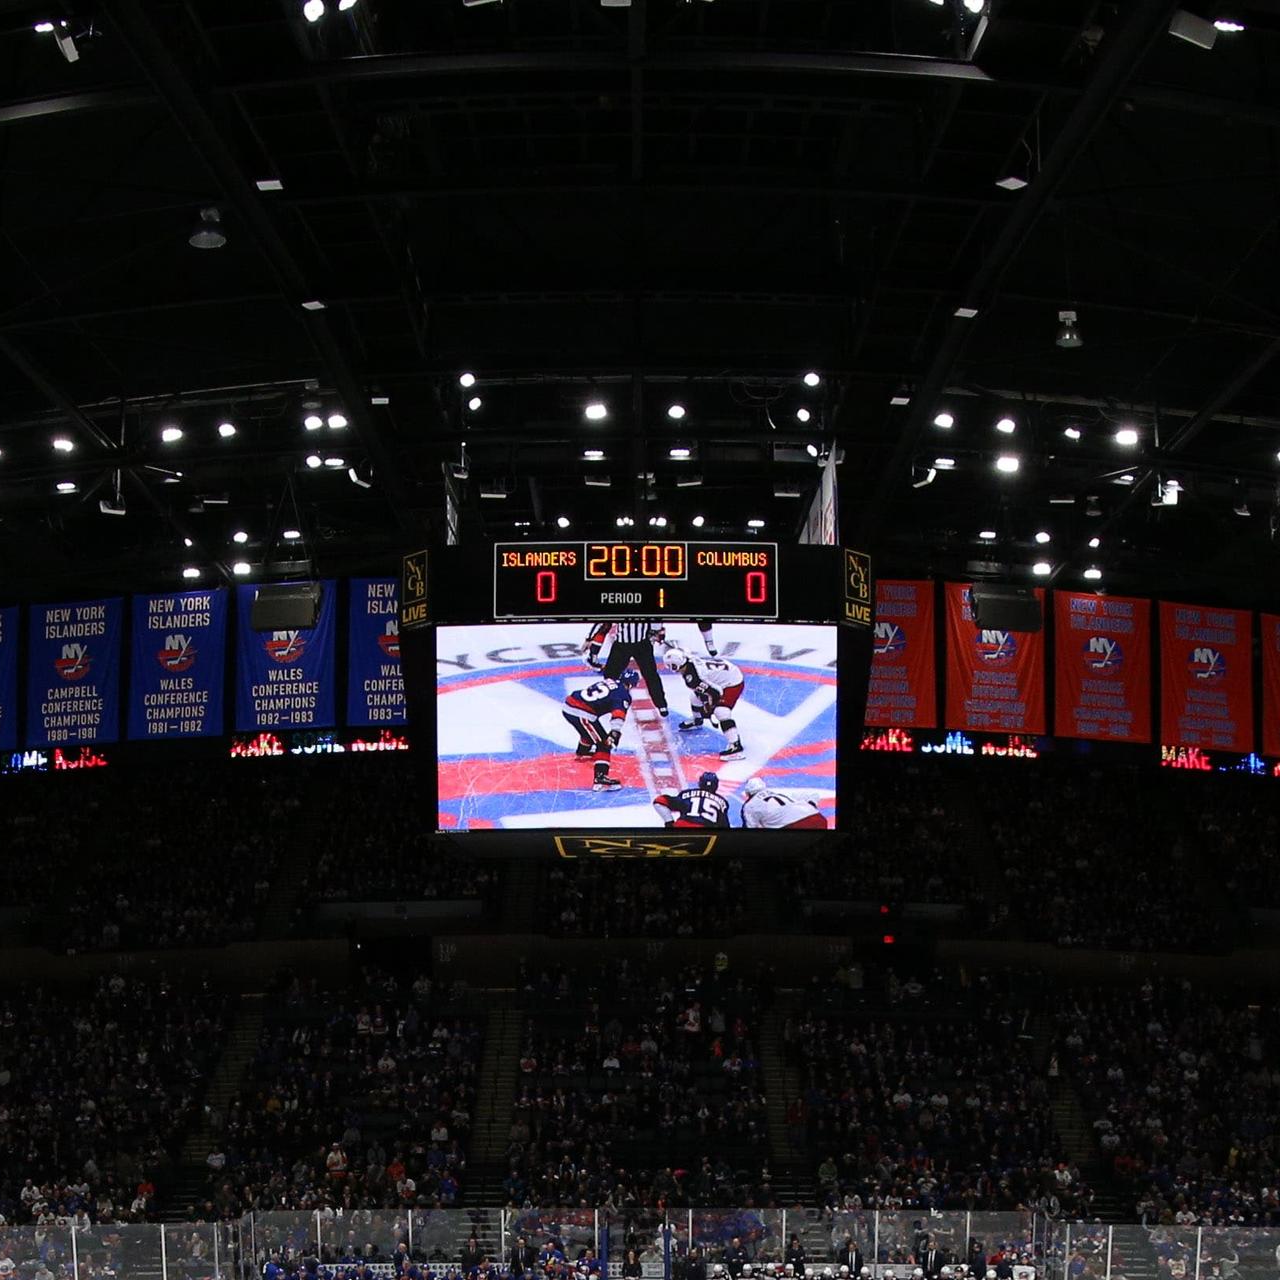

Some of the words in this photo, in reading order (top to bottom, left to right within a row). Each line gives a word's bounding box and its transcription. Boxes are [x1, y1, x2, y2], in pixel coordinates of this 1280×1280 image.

[502, 552, 576, 567] ISLANDERS
[590, 545, 683, 576] 20:00
[697, 551, 767, 567] COLUMBUS
[367, 583, 395, 598] NEW
[536, 571, 556, 602] 0
[746, 571, 766, 602] 0
[149, 599, 175, 613] NEW
[180, 596, 210, 611] YORK
[600, 591, 642, 604] PERIOD
[46, 609, 70, 622] NEW
[76, 606, 105, 620] YORK
[402, 604, 427, 623] LIVE
[846, 602, 871, 622] LIVE
[148, 612, 210, 629] ISLANDERS
[45, 622, 105, 639] ISLANDERS
[268, 667, 303, 681] WALES
[160, 677, 193, 691] WALES
[252, 681, 319, 697] CONFERENCE
[47, 685, 98, 700] CAMPBELL
[144, 690, 208, 706] CONFERENCE
[42, 698, 103, 715] CONFERENCE
[255, 696, 316, 711] CHAMPIONS
[146, 705, 205, 720] CHAMPIONS
[44, 713, 100, 729] CHAMPIONS
[1161, 745, 1212, 771] MAKE
[686, 798, 722, 819] 15
